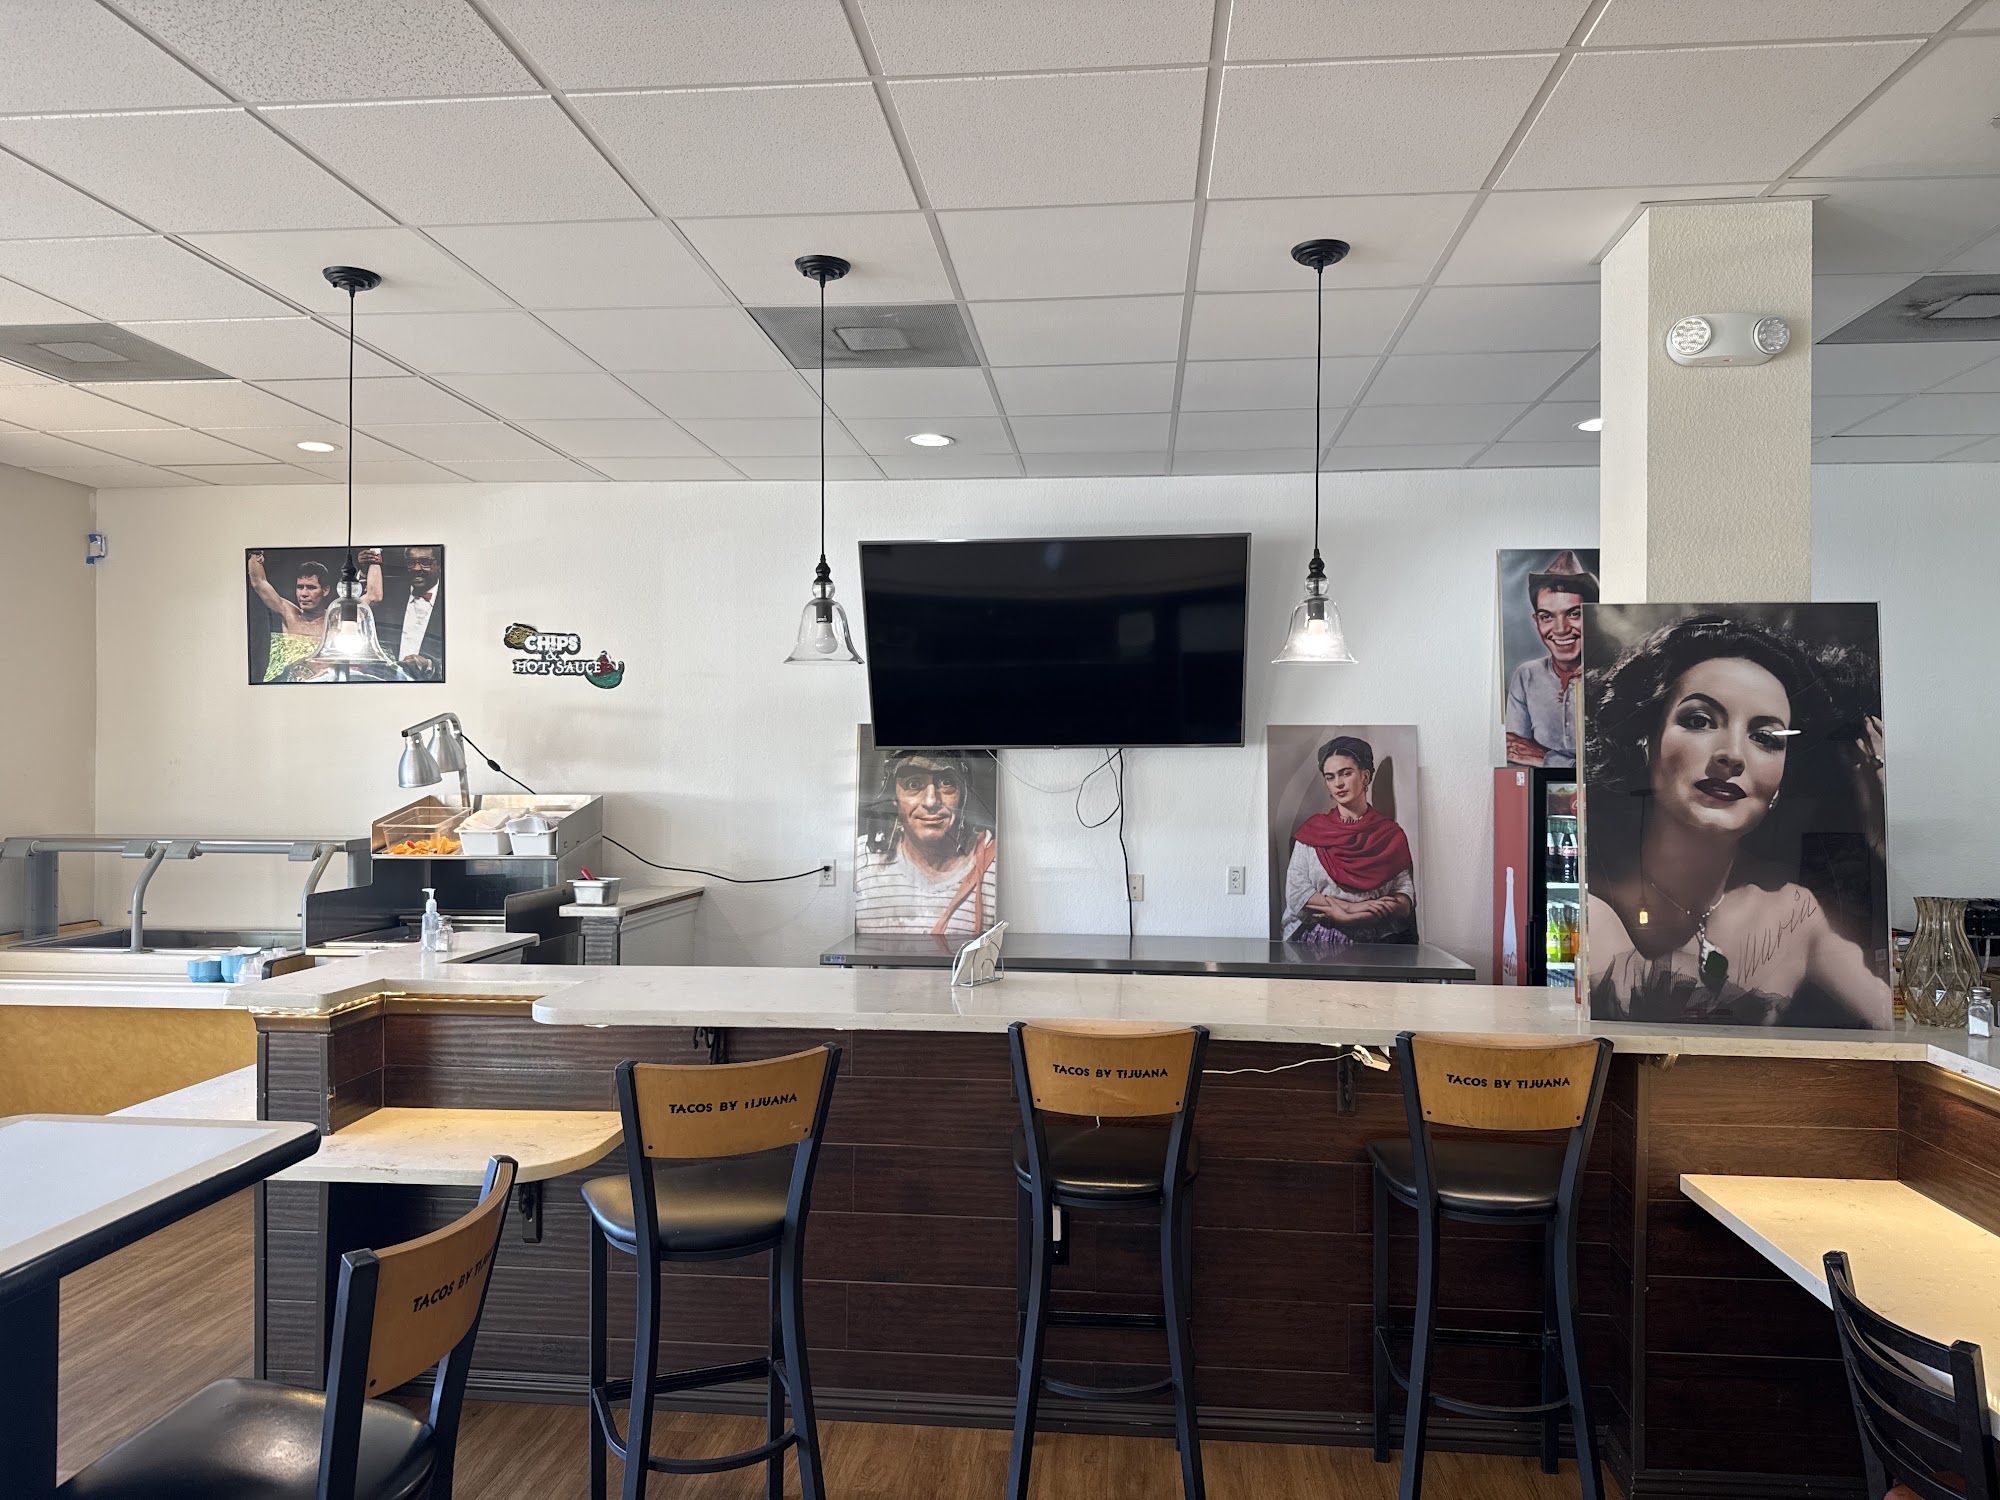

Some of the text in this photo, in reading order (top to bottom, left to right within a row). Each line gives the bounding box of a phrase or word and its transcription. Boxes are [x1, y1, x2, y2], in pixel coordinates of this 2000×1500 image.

[524, 634, 579, 652] CHIPS
[545, 647, 559, 661] &
[513, 661, 601, 674] HOT SAUCE
[1053, 1064, 1168, 1079] TACOS BY TIJUANA
[1446, 1073, 1571, 1089] TACOS BY TIJUANA
[668, 1102, 713, 1114] TACOS
[719, 1100, 739, 1112] BY
[413, 1281, 455, 1313] TACOS
[457, 1268, 473, 1290] BY
